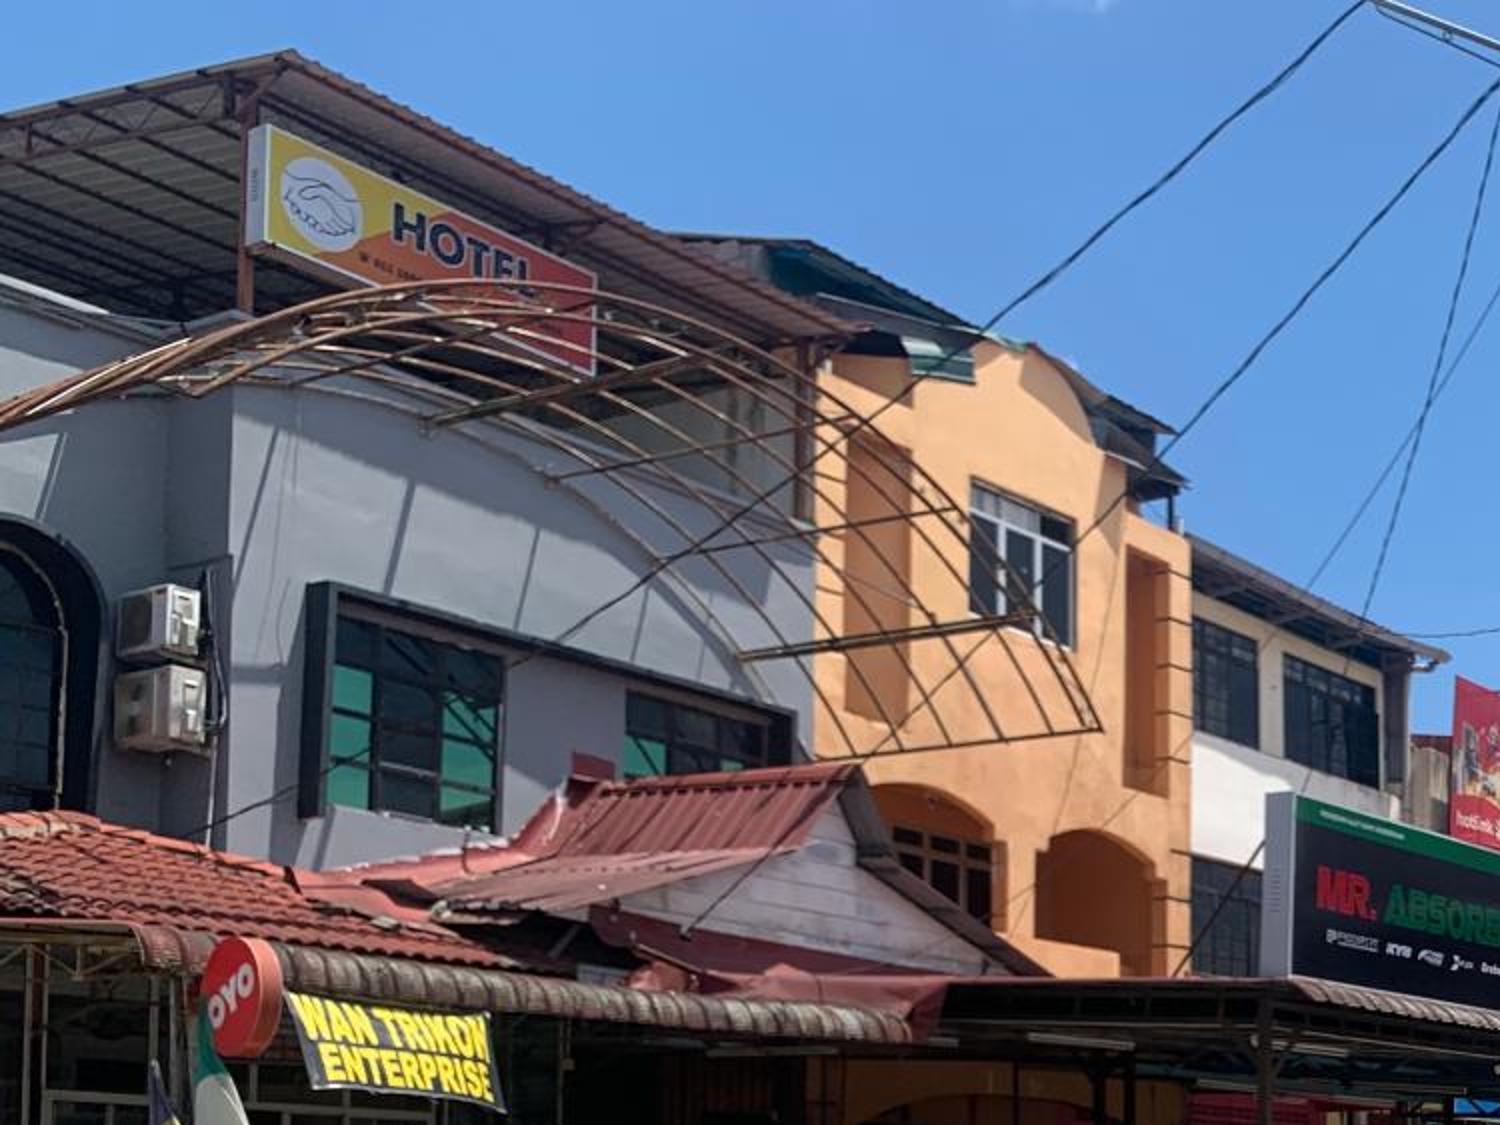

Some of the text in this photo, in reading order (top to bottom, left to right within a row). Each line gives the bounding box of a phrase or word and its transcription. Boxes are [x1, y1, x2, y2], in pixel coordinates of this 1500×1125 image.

[392, 202, 536, 297] HOTEL
[1316, 864, 1377, 920] MR.
[207, 962, 255, 1029] OYO
[288, 992, 380, 1046] WAN
[317, 1041, 496, 1104] ENTERPRISE
